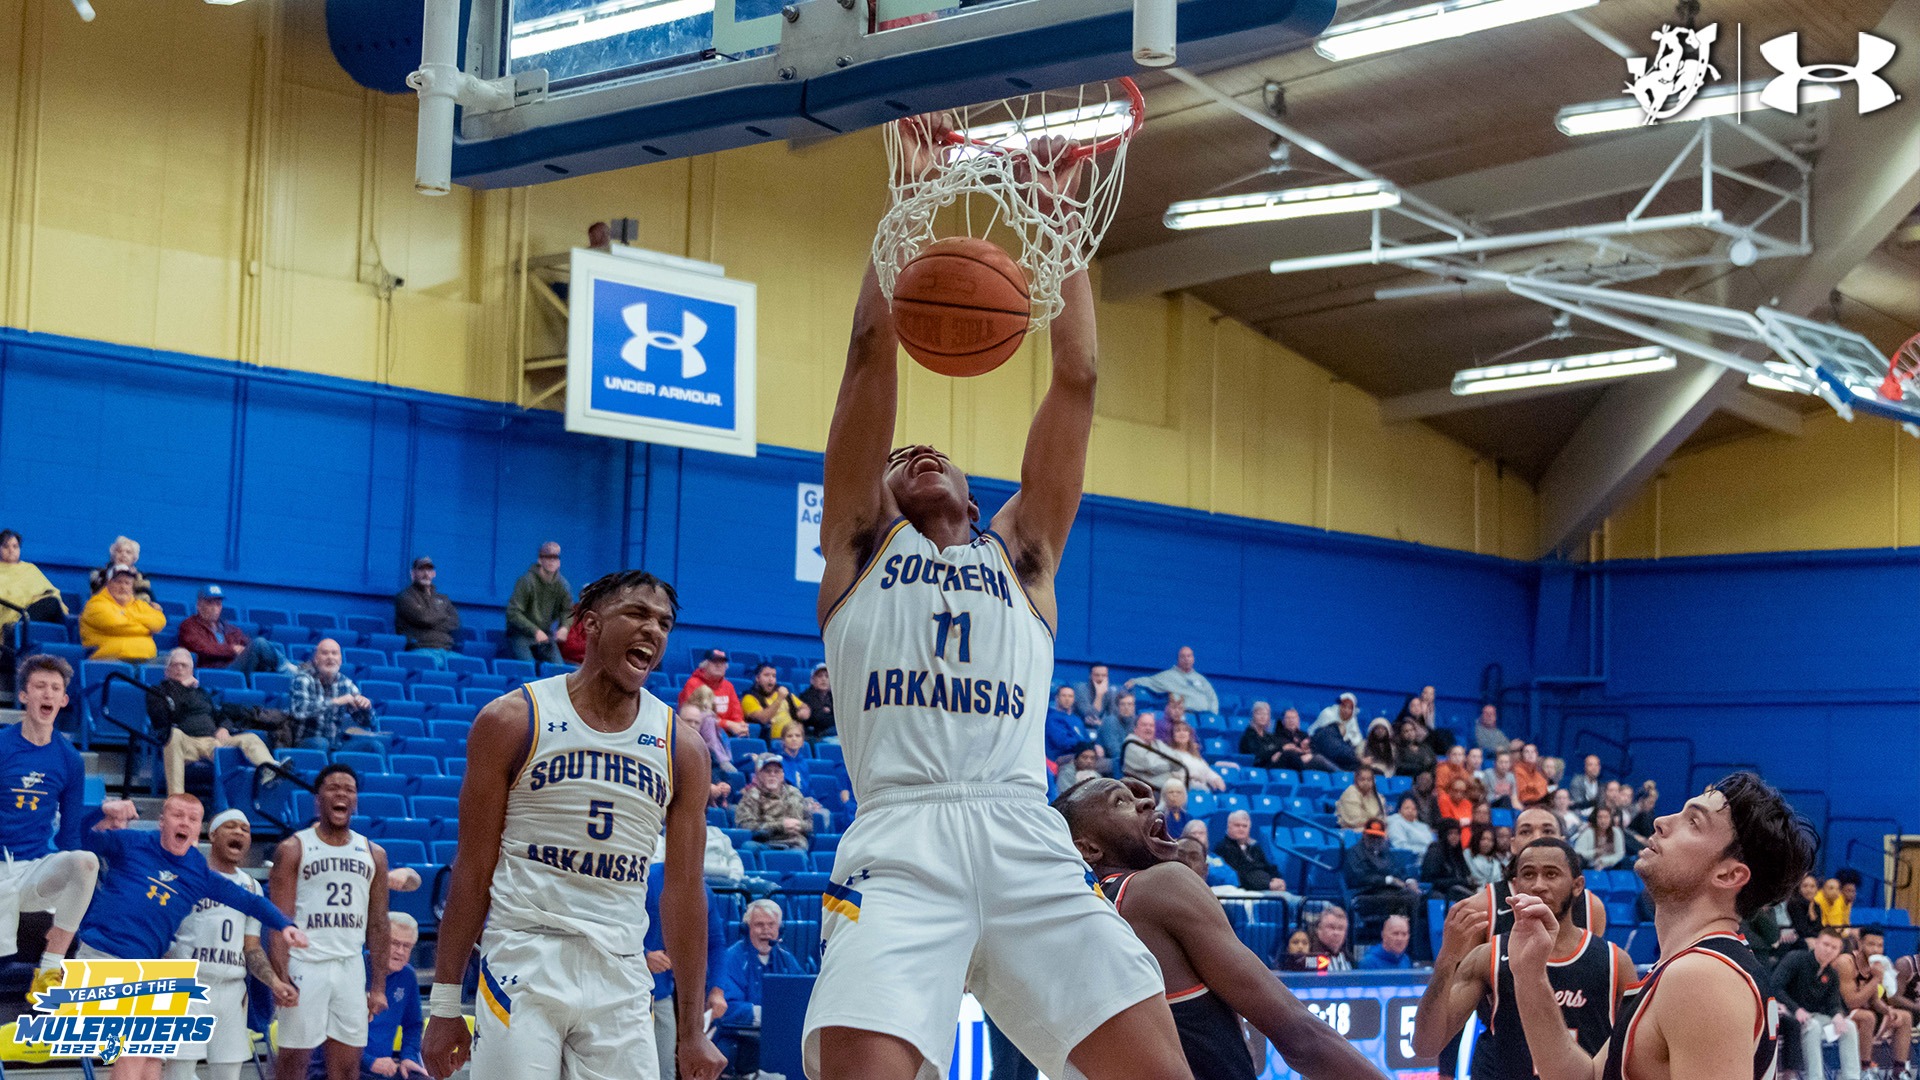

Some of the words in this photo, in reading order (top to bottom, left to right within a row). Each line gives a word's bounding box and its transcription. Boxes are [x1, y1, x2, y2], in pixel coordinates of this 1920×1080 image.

[604, 375, 656, 396] UNDER
[804, 490, 824, 508] G
[932, 611, 971, 663] 11
[863, 668, 1025, 719] ARKANSAS
[637, 733, 667, 749] GAC
[530, 750, 667, 808] SOUTHERN
[587, 800, 614, 841] 5
[303, 857, 373, 882] SOUTHERN
[527, 844, 648, 882] ARKANSAS
[326, 882, 353, 906] 23
[222, 919, 233, 943] 0
